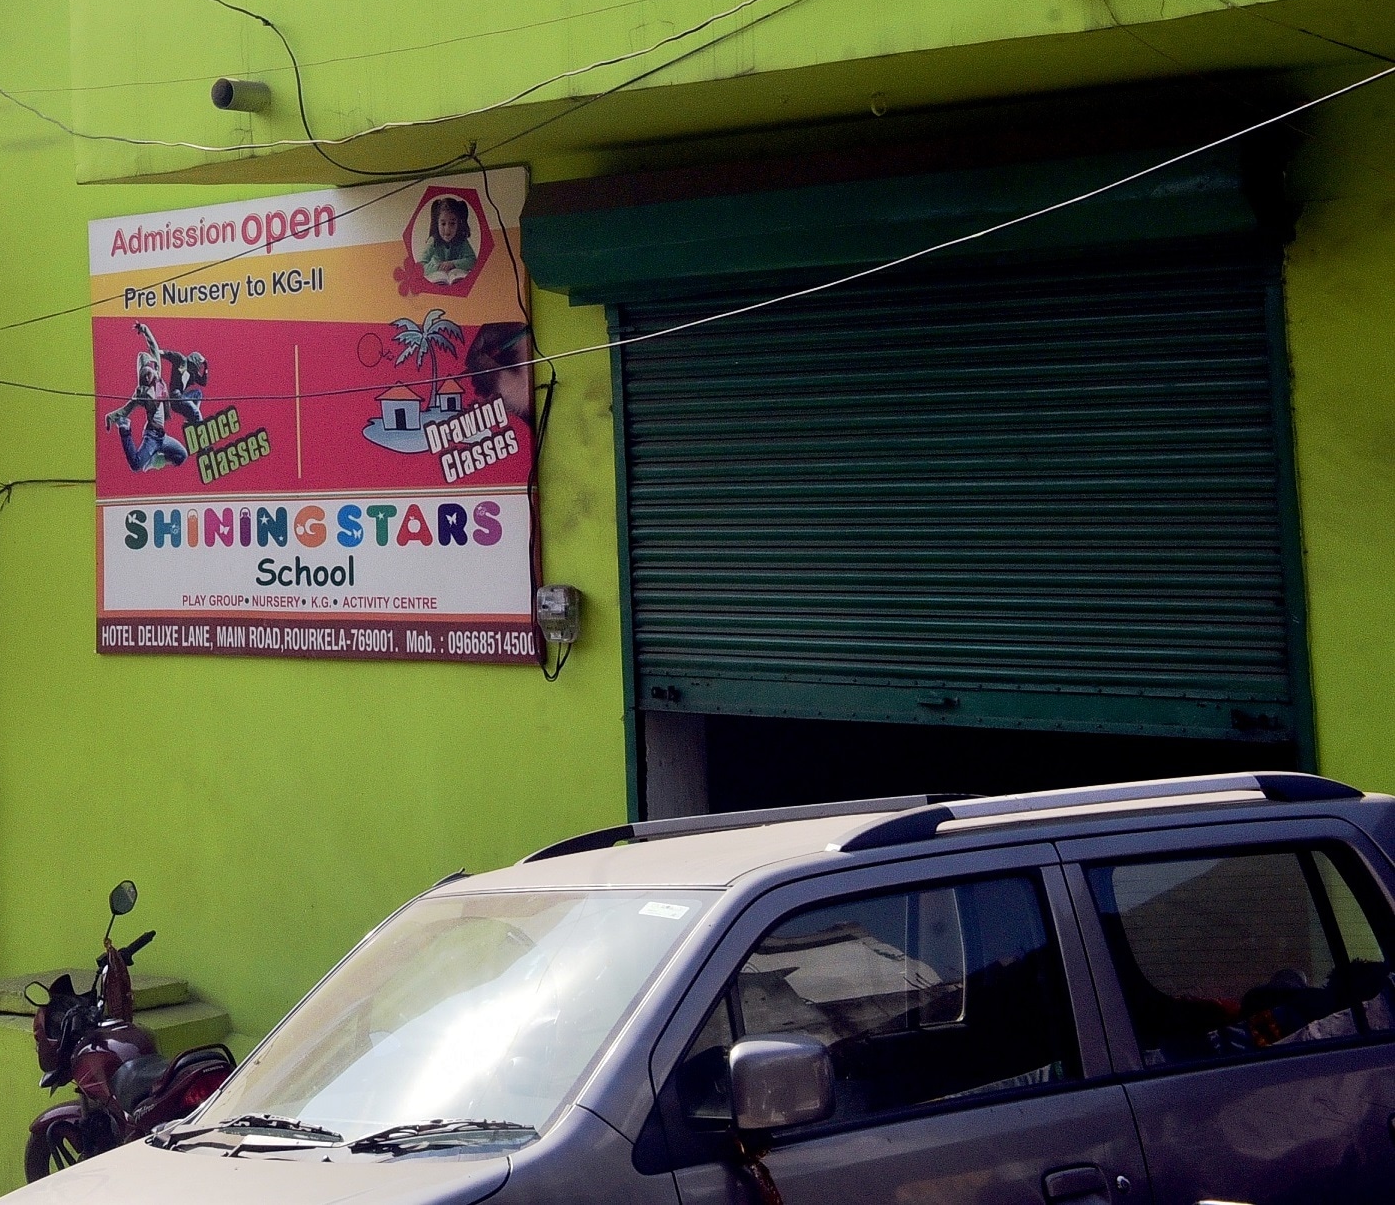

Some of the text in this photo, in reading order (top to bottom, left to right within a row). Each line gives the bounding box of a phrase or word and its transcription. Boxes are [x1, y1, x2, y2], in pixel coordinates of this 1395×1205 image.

[111, 203, 336, 257] Admission open
[124, 267, 323, 309] Pre Nursery to KG-II
[185, 409, 240, 455] Dance
[426, 398, 508, 454] Drawing
[198, 431, 271, 484] Classes
[441, 430, 519, 483] Classes
[124, 501, 503, 550] SHINING STARS
[255, 556, 355, 587] School
[182, 595, 438, 610] PLAY GROUP NURSERY K.G. ACTIVITY CENTRE
[102, 625, 135, 646] HOTEL
[138, 625, 179, 647] DELUXE
[182, 626, 214, 650] LANE,
[217, 626, 246, 648] MAIN
